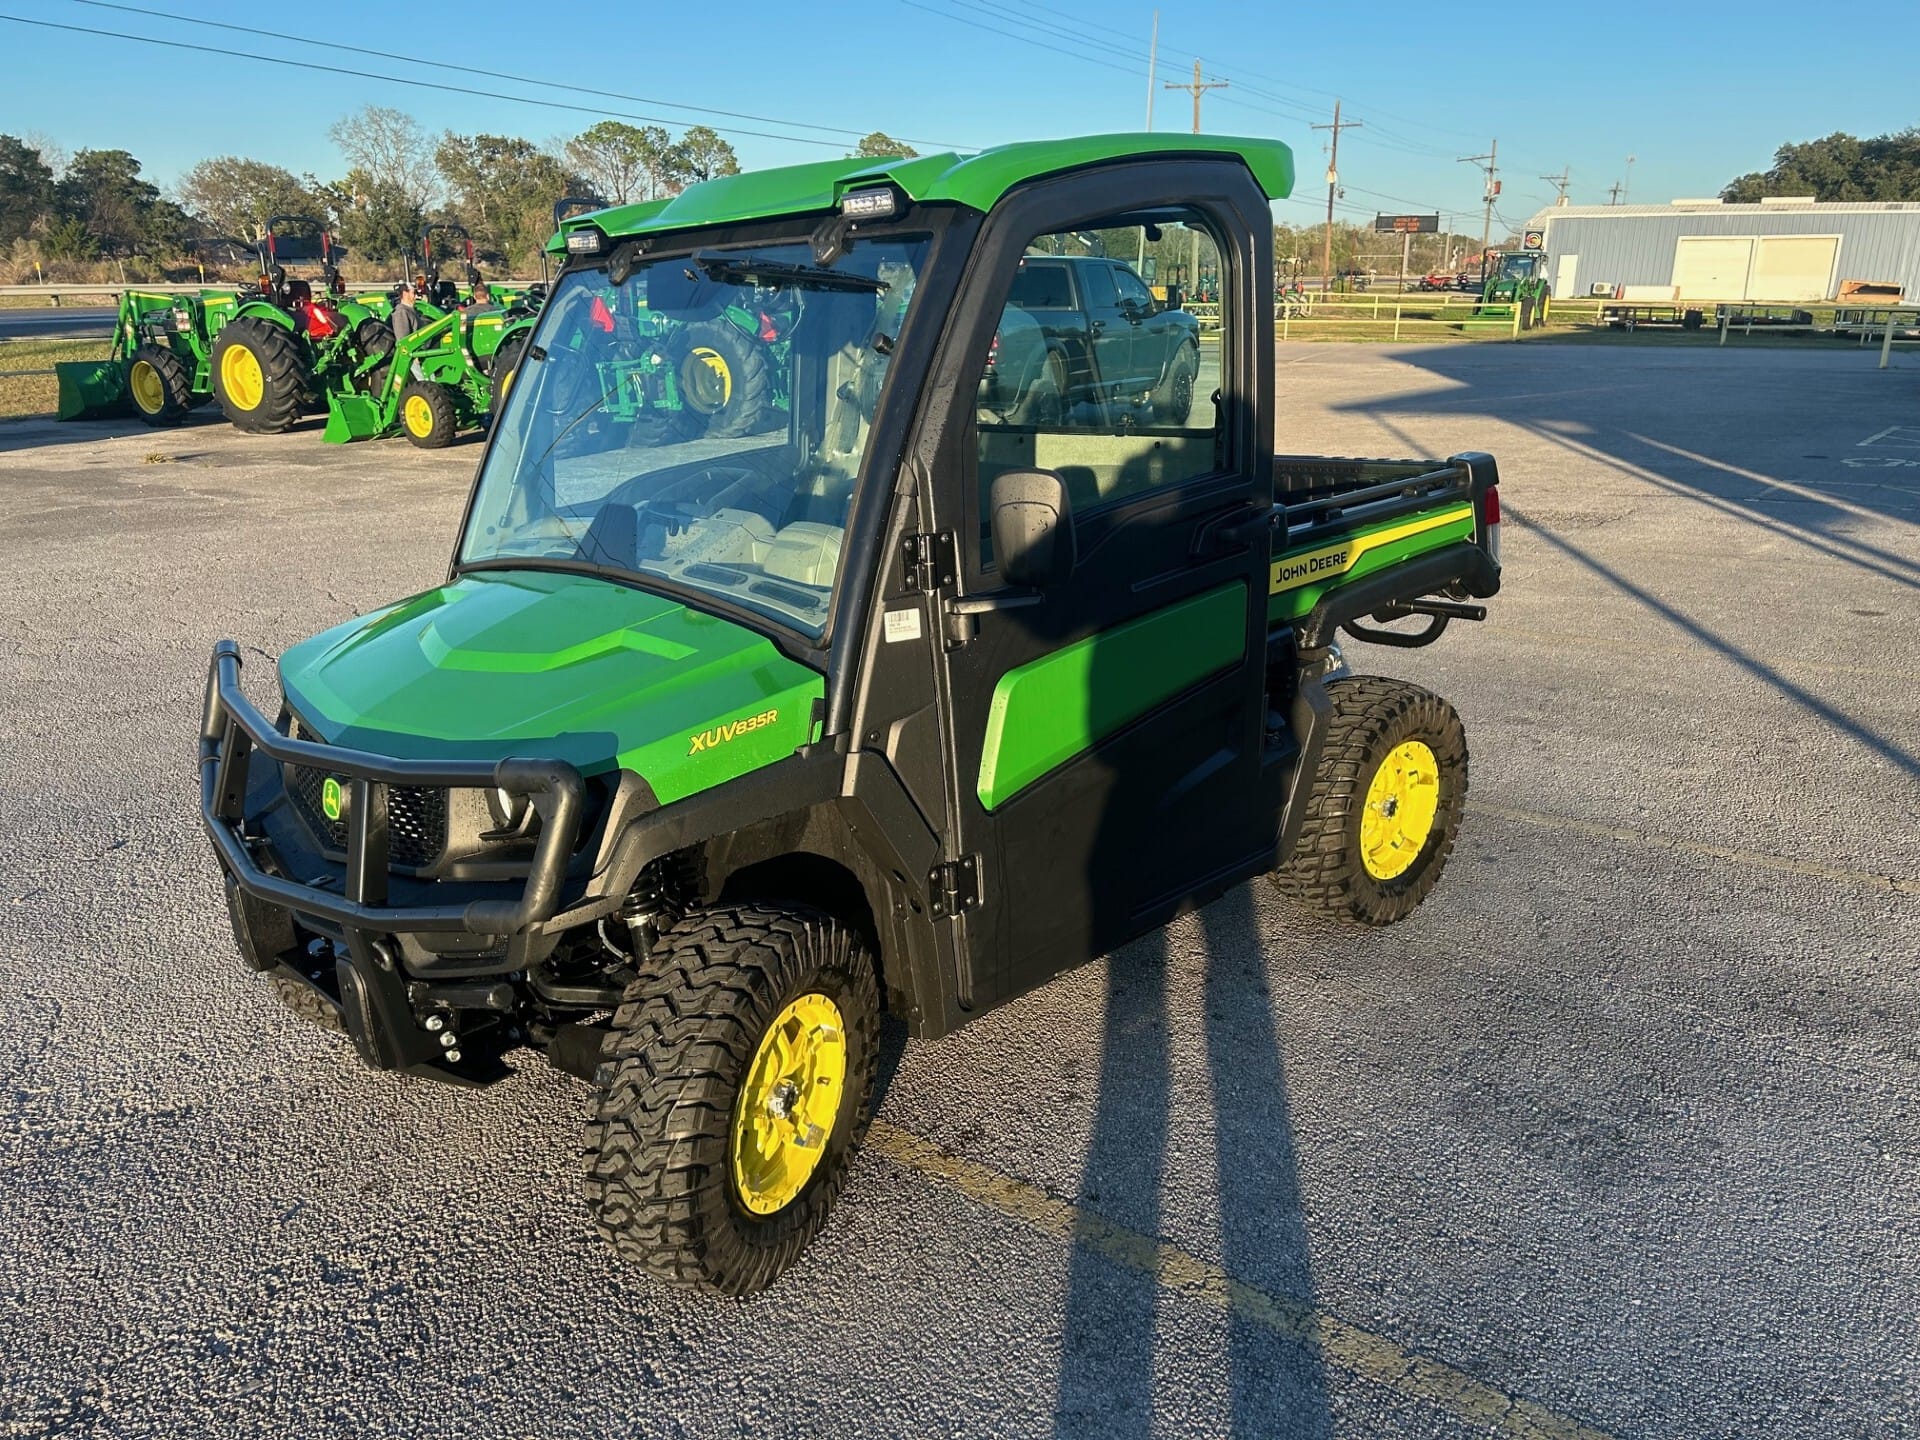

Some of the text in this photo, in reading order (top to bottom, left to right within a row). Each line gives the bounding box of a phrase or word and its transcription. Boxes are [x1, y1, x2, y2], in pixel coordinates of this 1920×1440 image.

[1276, 551, 1348, 584] JOHN DEERE
[688, 709, 778, 755] XUV835R
